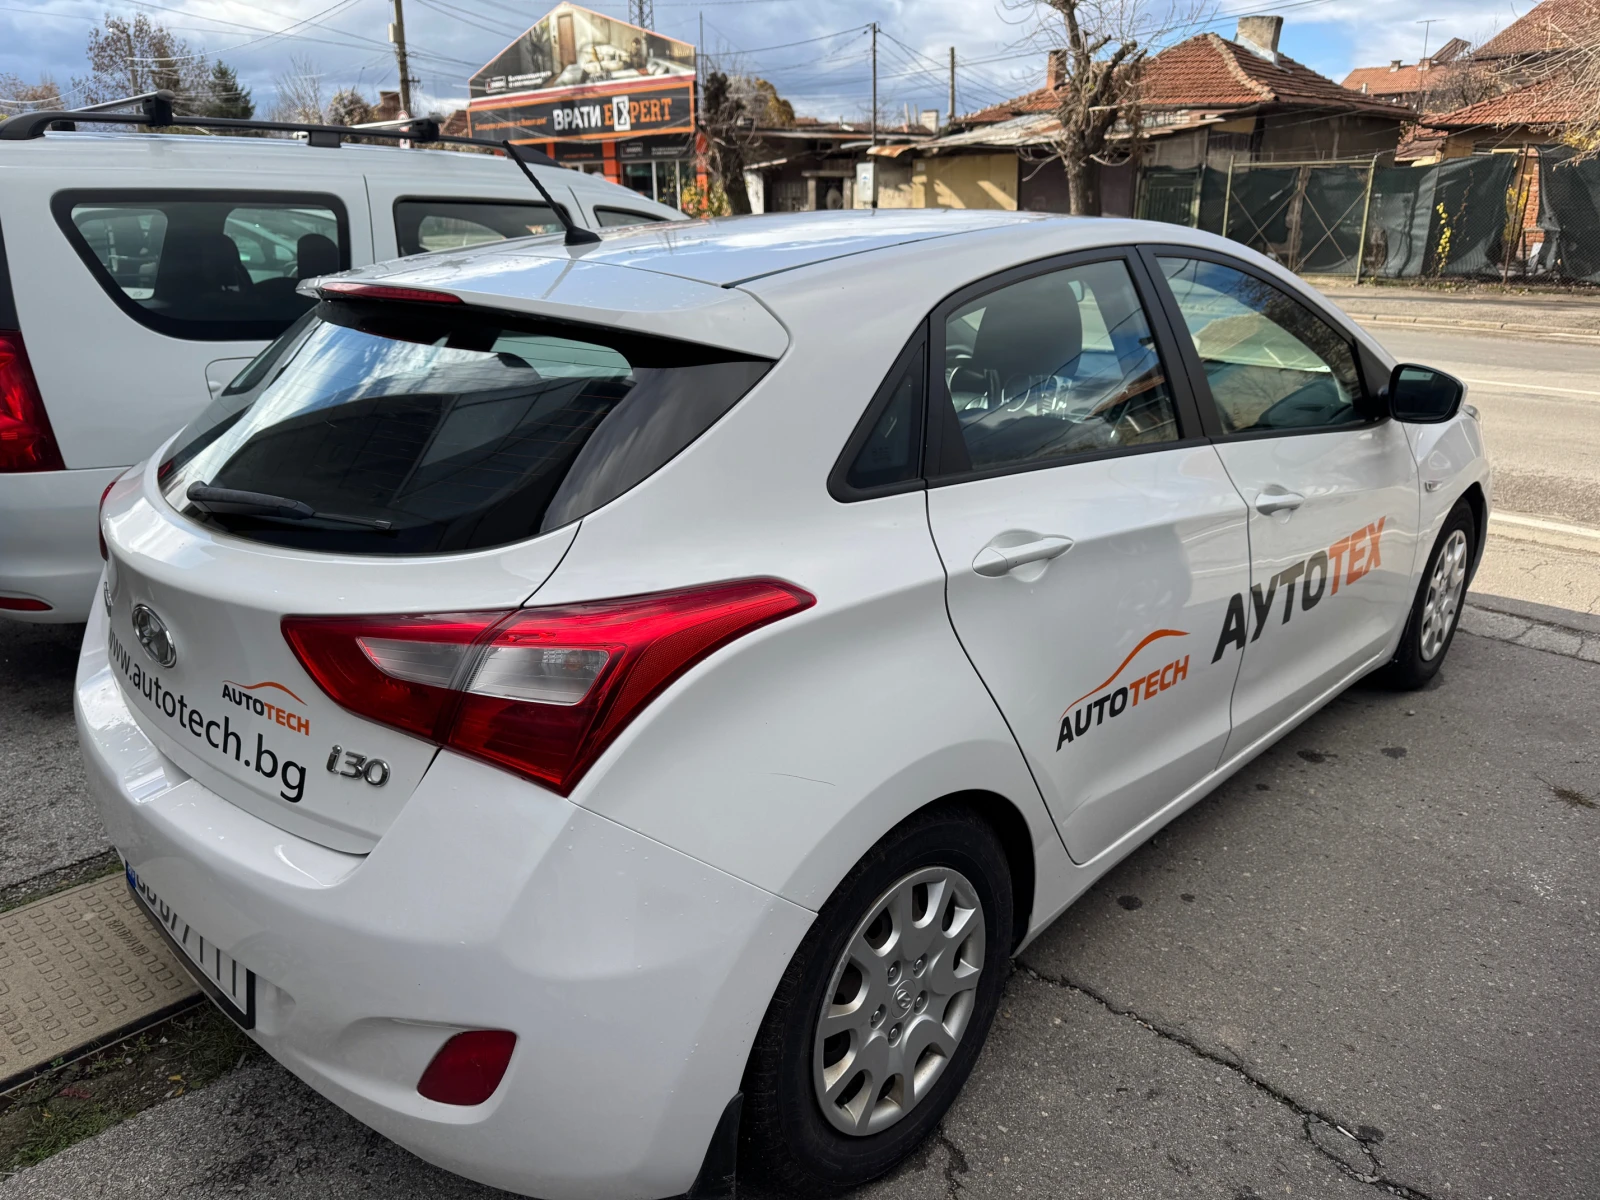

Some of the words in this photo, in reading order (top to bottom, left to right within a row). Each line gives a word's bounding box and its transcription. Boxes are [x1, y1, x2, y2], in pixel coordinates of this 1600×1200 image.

[553, 105, 602, 130] ВРАТИ
[222, 684, 310, 736] AUTOTECH
[1056, 655, 1190, 753] AUTOTECH
[326, 745, 391, 787] i30
